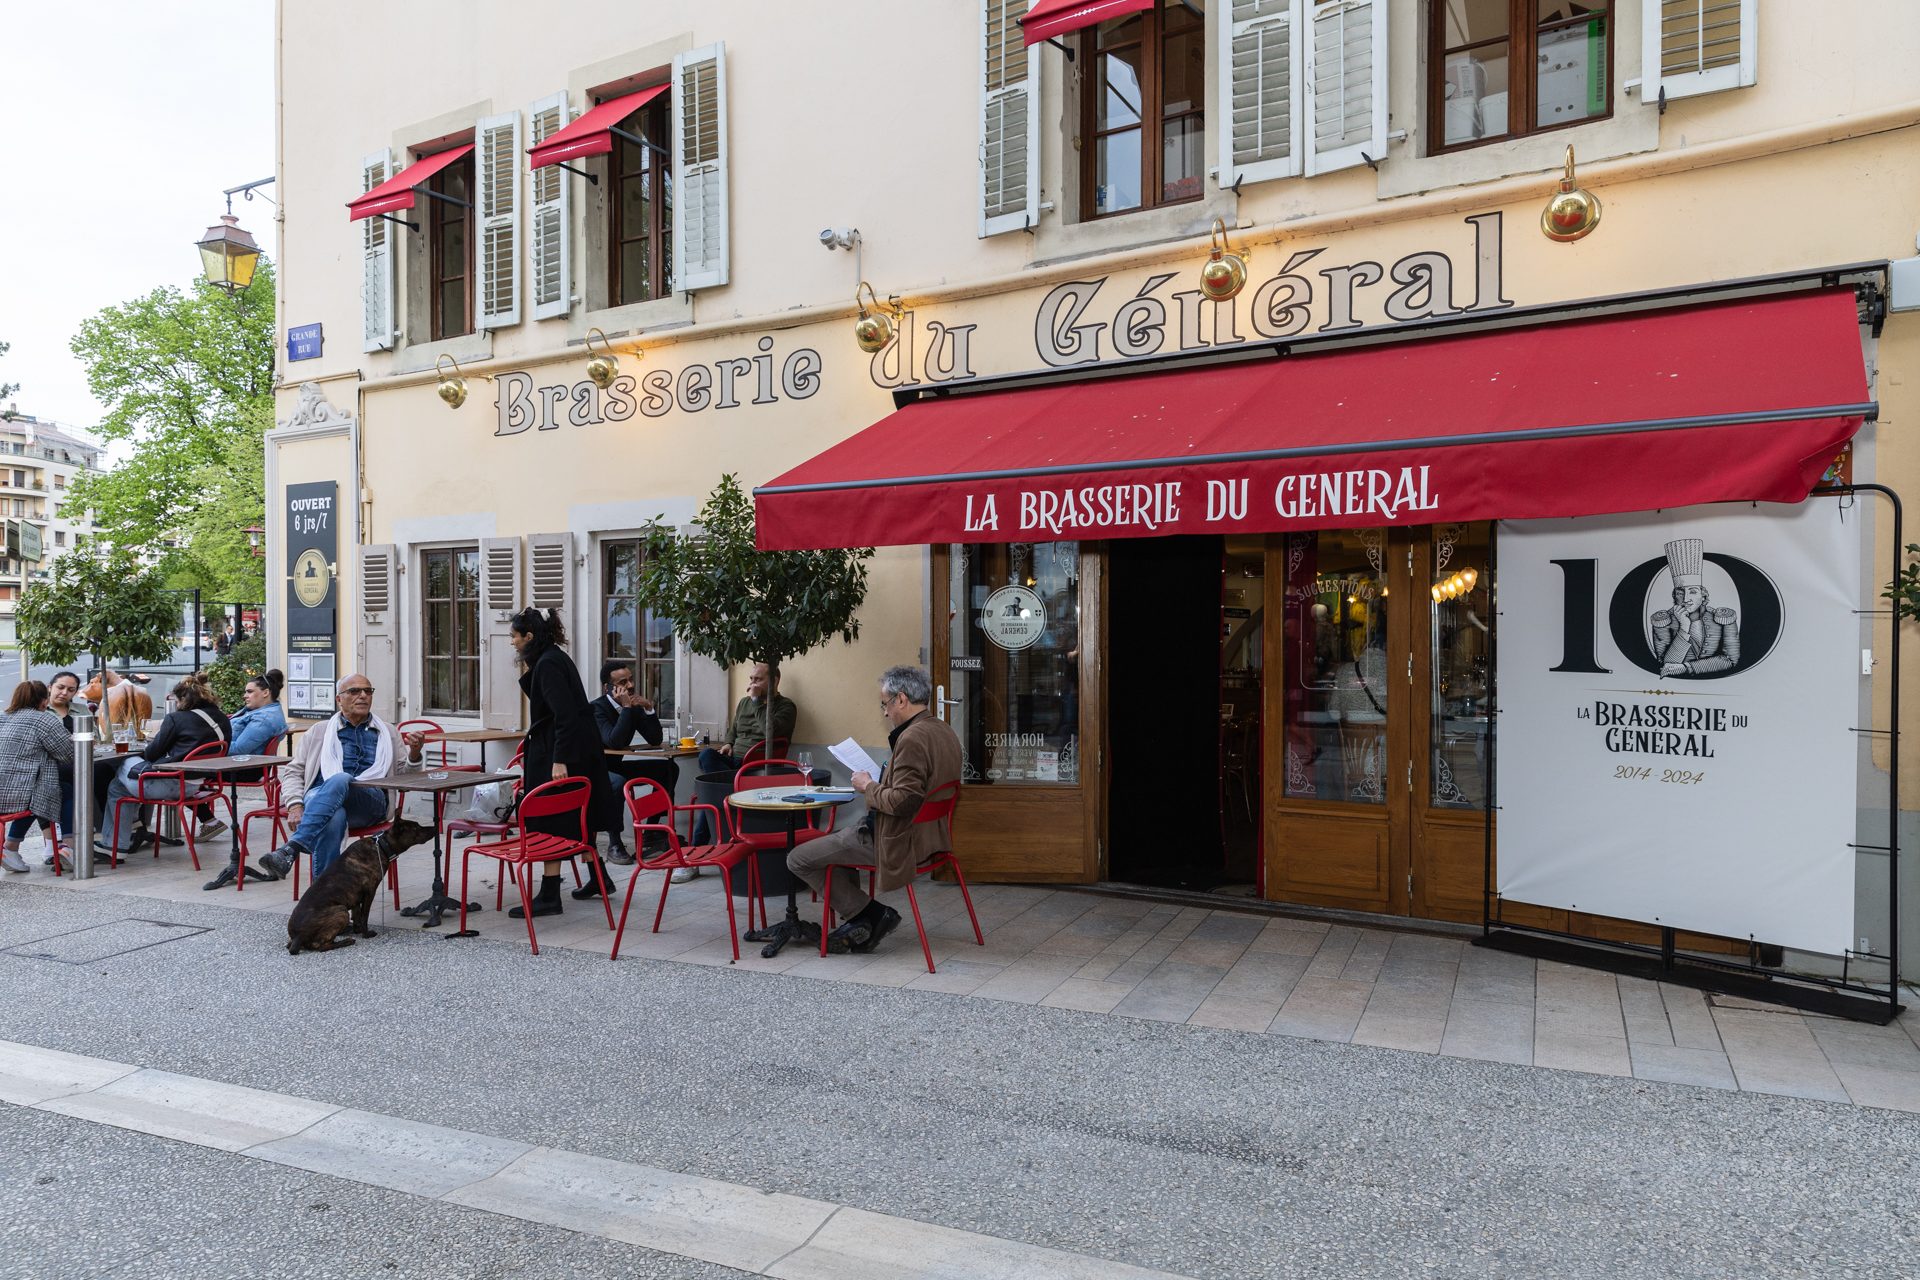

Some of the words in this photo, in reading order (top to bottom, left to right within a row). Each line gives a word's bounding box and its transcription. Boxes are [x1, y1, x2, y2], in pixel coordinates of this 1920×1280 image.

[291, 329, 318, 342] GRANDE
[494, 335, 822, 436] Brasserie
[869, 311, 977, 388] du
[1034, 211, 1515, 366] Général
[297, 344, 312, 354] RUE
[291, 496, 332, 512] OUVERT
[964, 494, 999, 532] LA
[1019, 481, 1183, 534] BRASSERIE
[1206, 478, 1249, 522] DU
[1275, 465, 1440, 520] GENERAL
[294, 514, 301, 531] 6
[303, 512, 328, 534] jrs/7
[1296, 578, 1375, 602] SUGGESTIONS
[1549, 552, 1786, 681] 10
[951, 659, 981, 668] POUSSEZ
[1577, 707, 1591, 719] LA
[1595, 701, 1728, 732] BRASSERIE
[1732, 714, 1749, 728] DU
[1605, 727, 1716, 758] GÉNÉRAL
